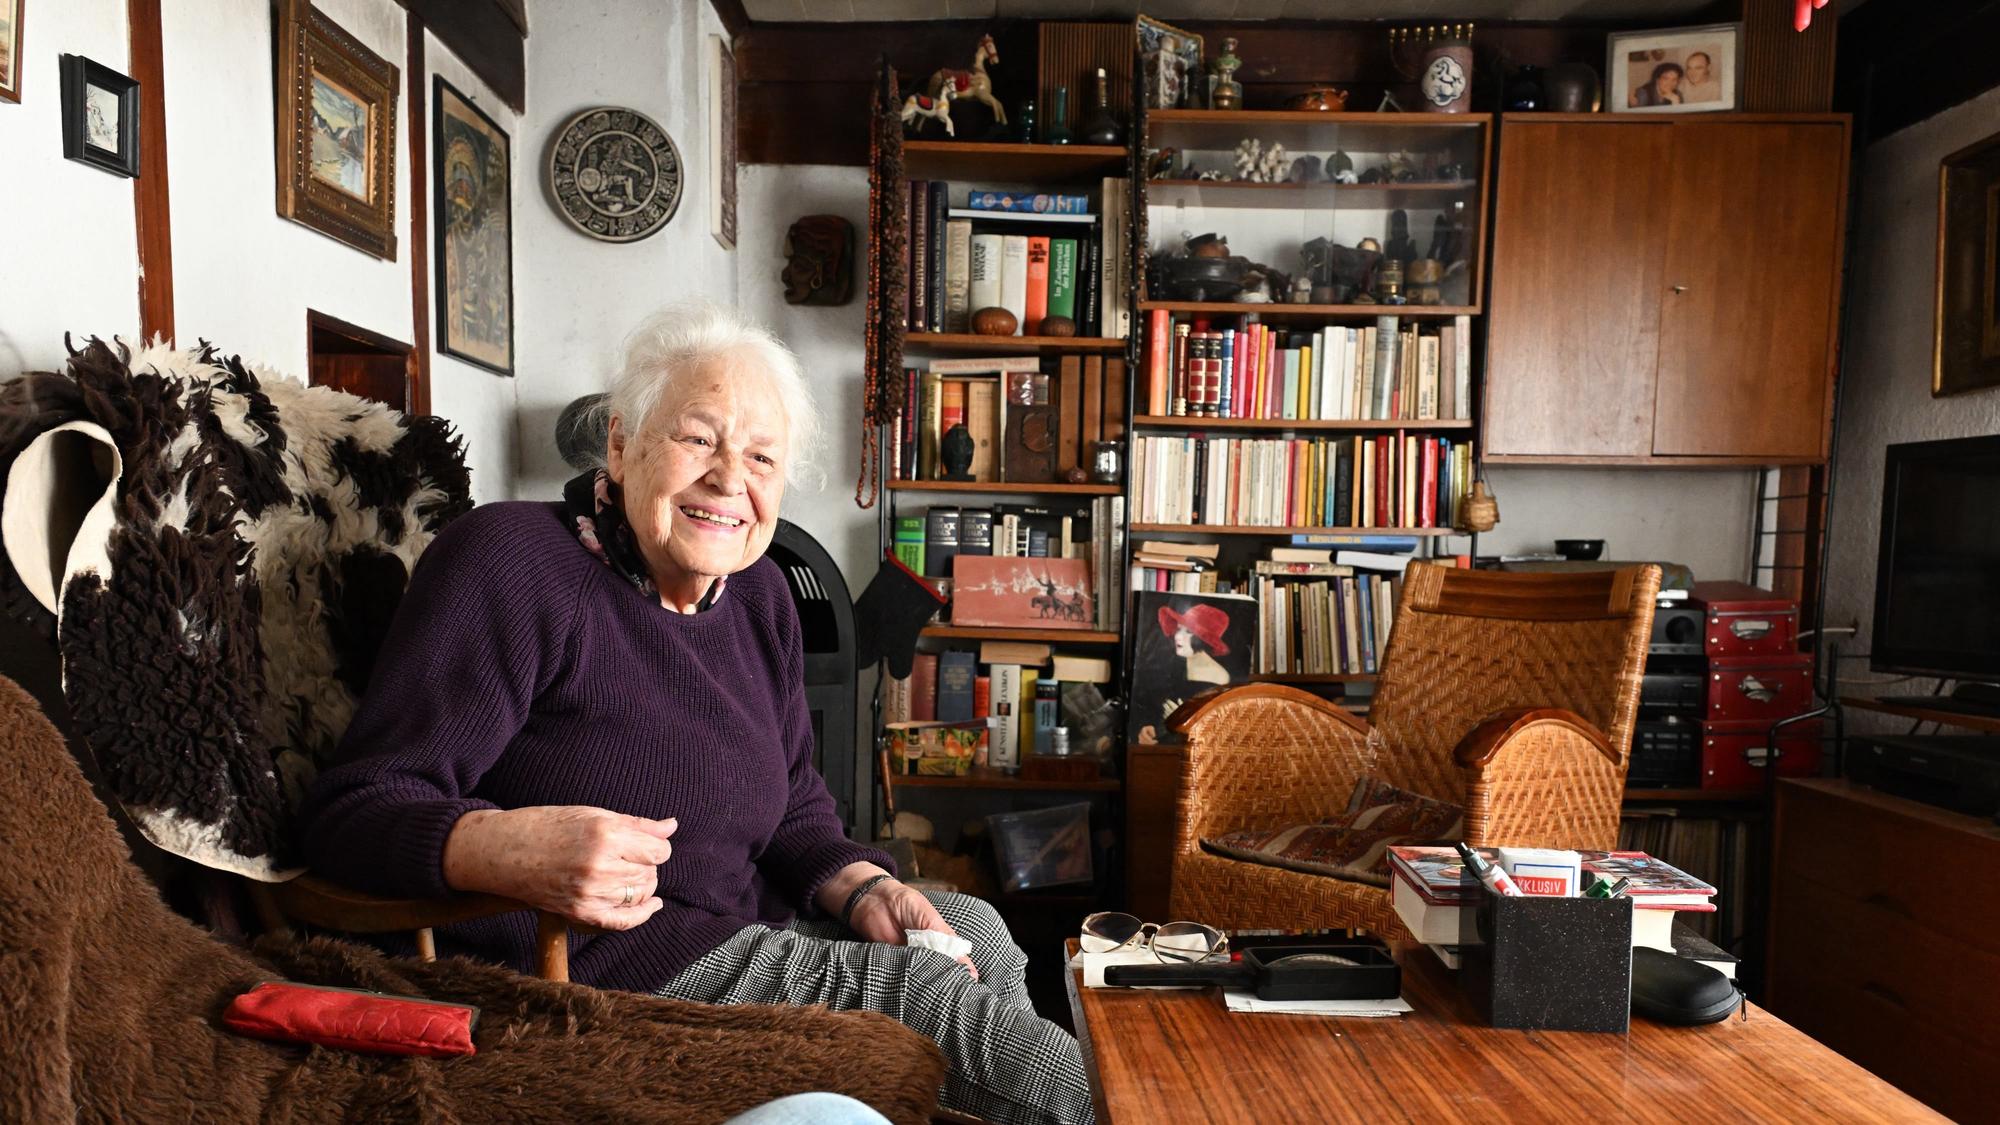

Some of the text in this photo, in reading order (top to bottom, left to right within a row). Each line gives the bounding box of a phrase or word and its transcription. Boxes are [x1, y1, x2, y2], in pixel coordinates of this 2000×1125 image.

[915, 236, 926, 307] JAHRTAUSEND
[1054, 244, 1064, 297] Im Zauberwald
[1062, 244, 1071, 288] der Märchen
[1104, 258, 1114, 281] Inka
[1001, 670, 1009, 702] LEXIKON
